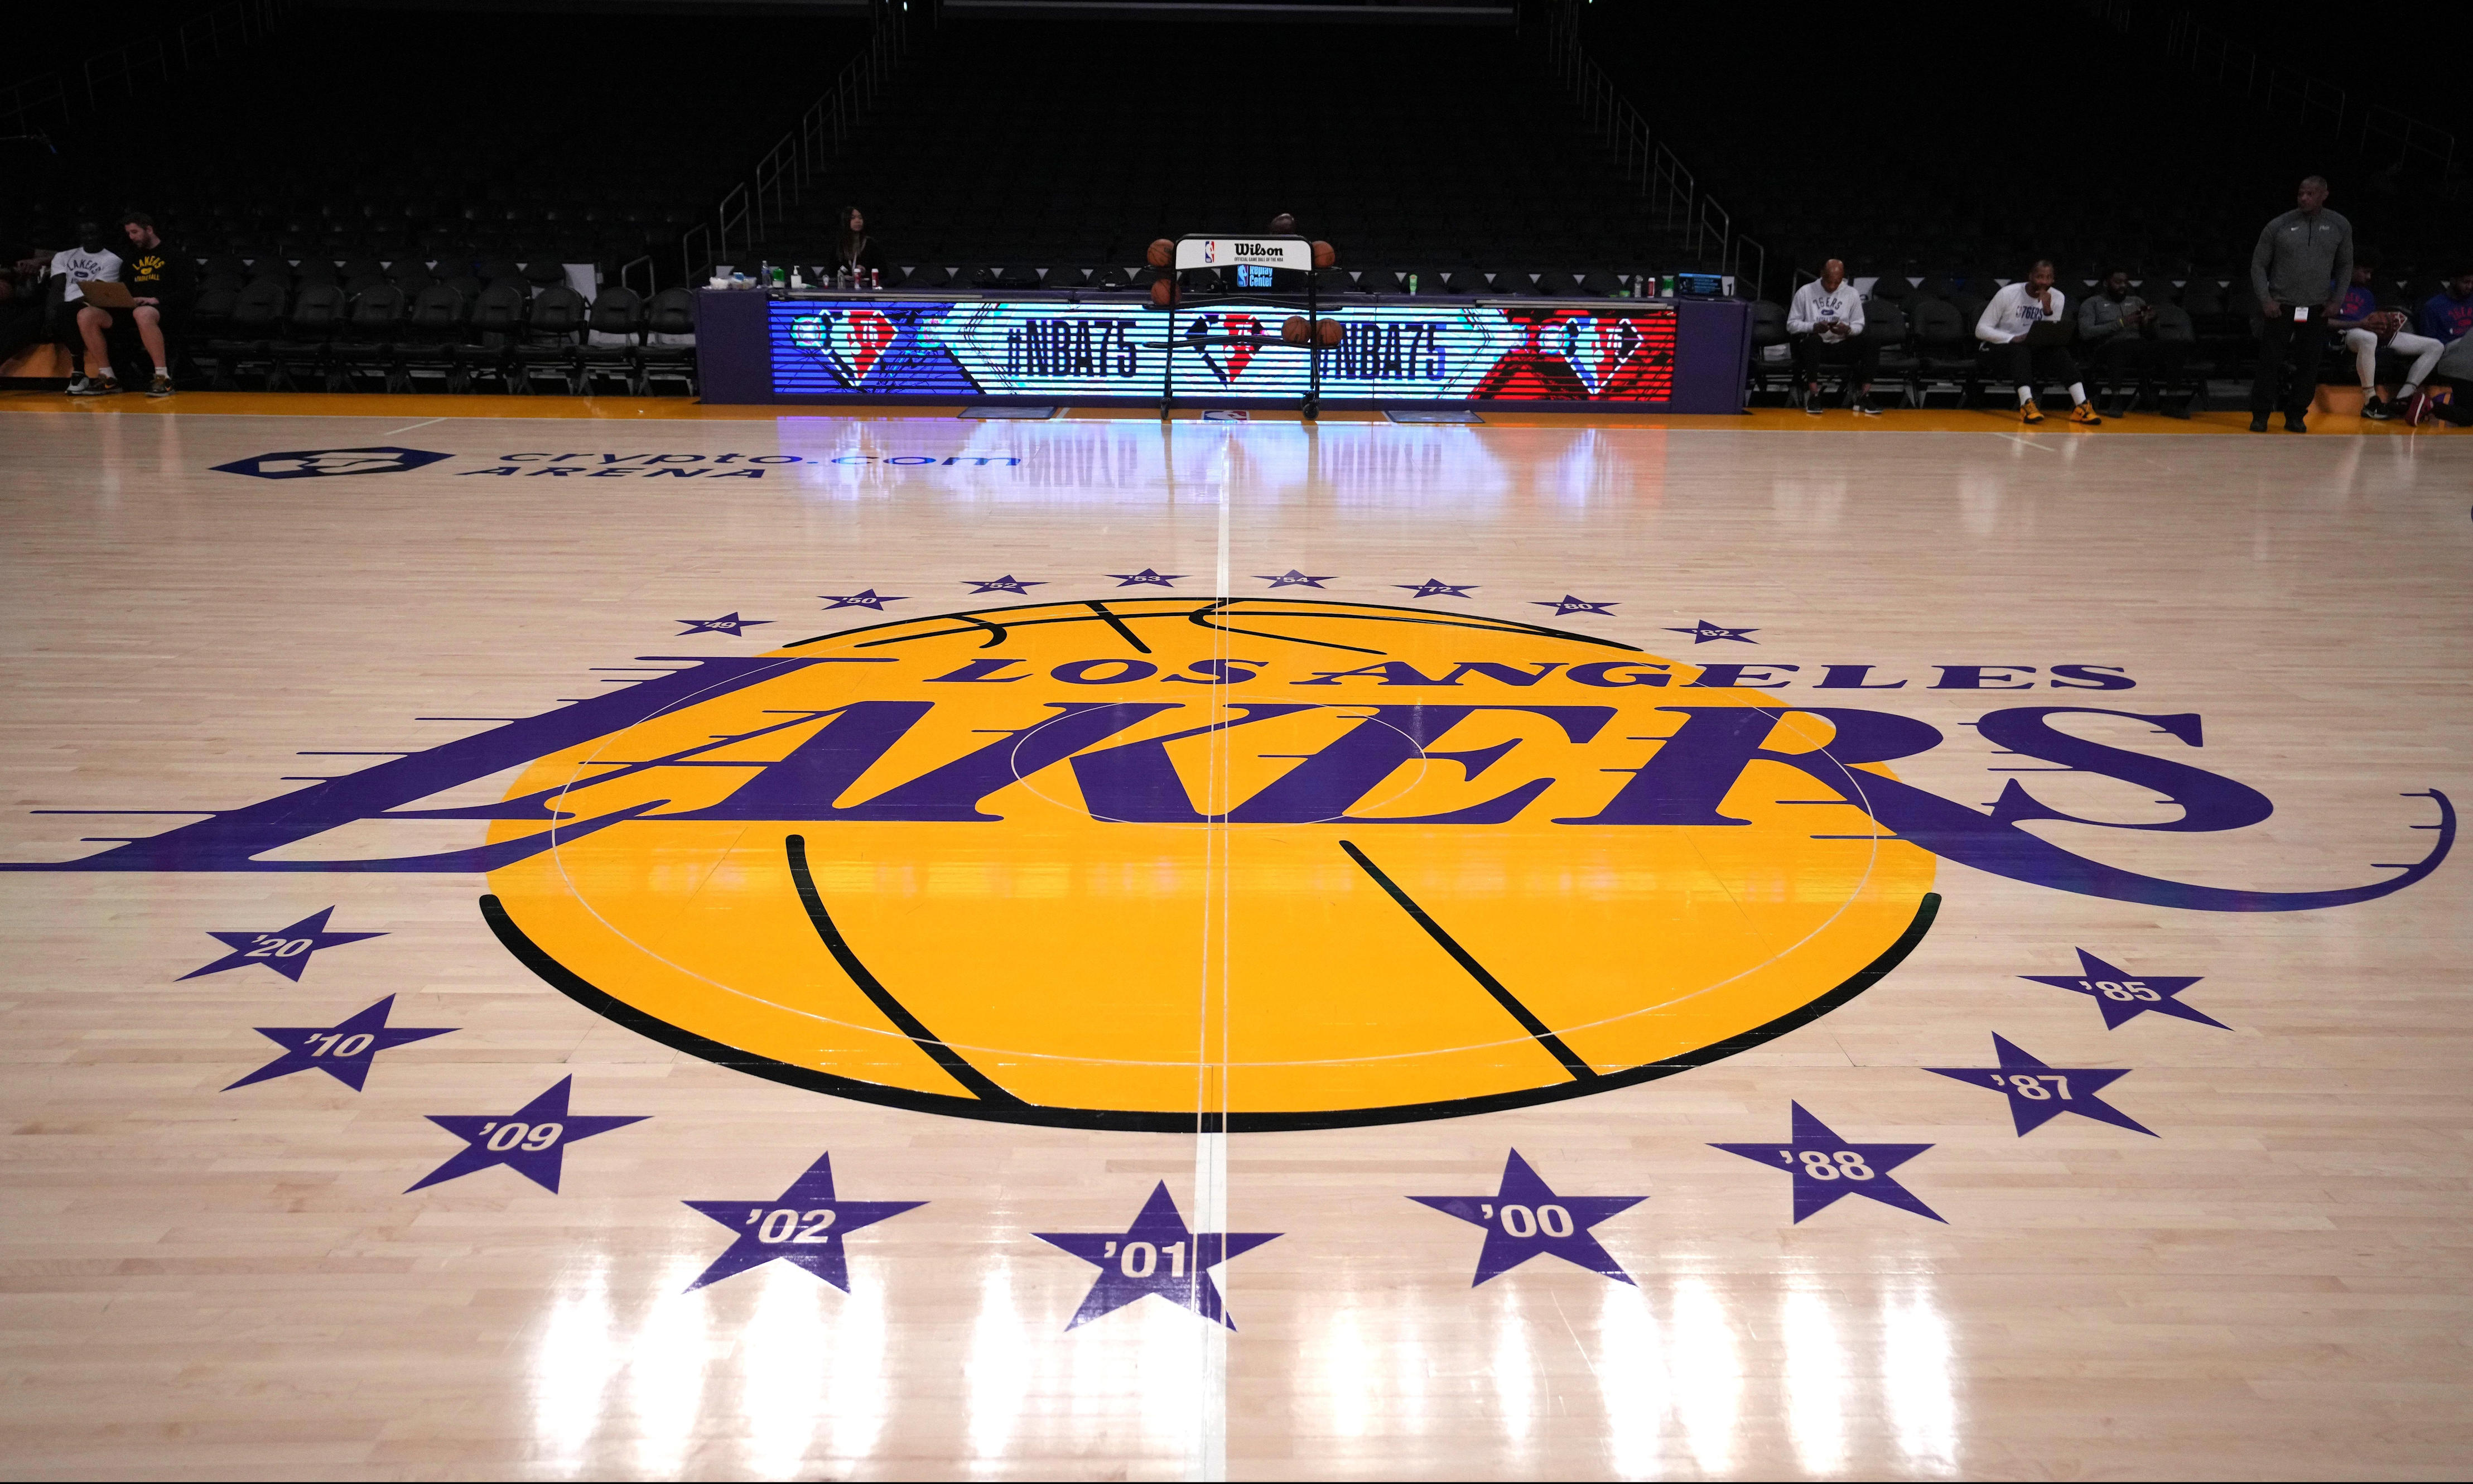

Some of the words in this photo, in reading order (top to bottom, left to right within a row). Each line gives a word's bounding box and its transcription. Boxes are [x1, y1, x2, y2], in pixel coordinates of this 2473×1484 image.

[1235, 243, 1283, 256] Wilson
[67, 259, 102, 274] LAKERS
[132, 256, 166, 270] LAKERS
[1250, 266, 1272, 277] Replay
[1250, 274, 1272, 286] Center
[1813, 297, 1843, 310] 76ERS
[2022, 305, 2043, 320] 76ERS
[1005, 319, 1137, 378] #NBA75
[500, 452, 1022, 465] crypto.com
[455, 466, 767, 478] ARENA
[924, 658, 1269, 685] LOS
[1290, 661, 2137, 690] ANGELES
[0, 656, 2456, 913] LAKERS
